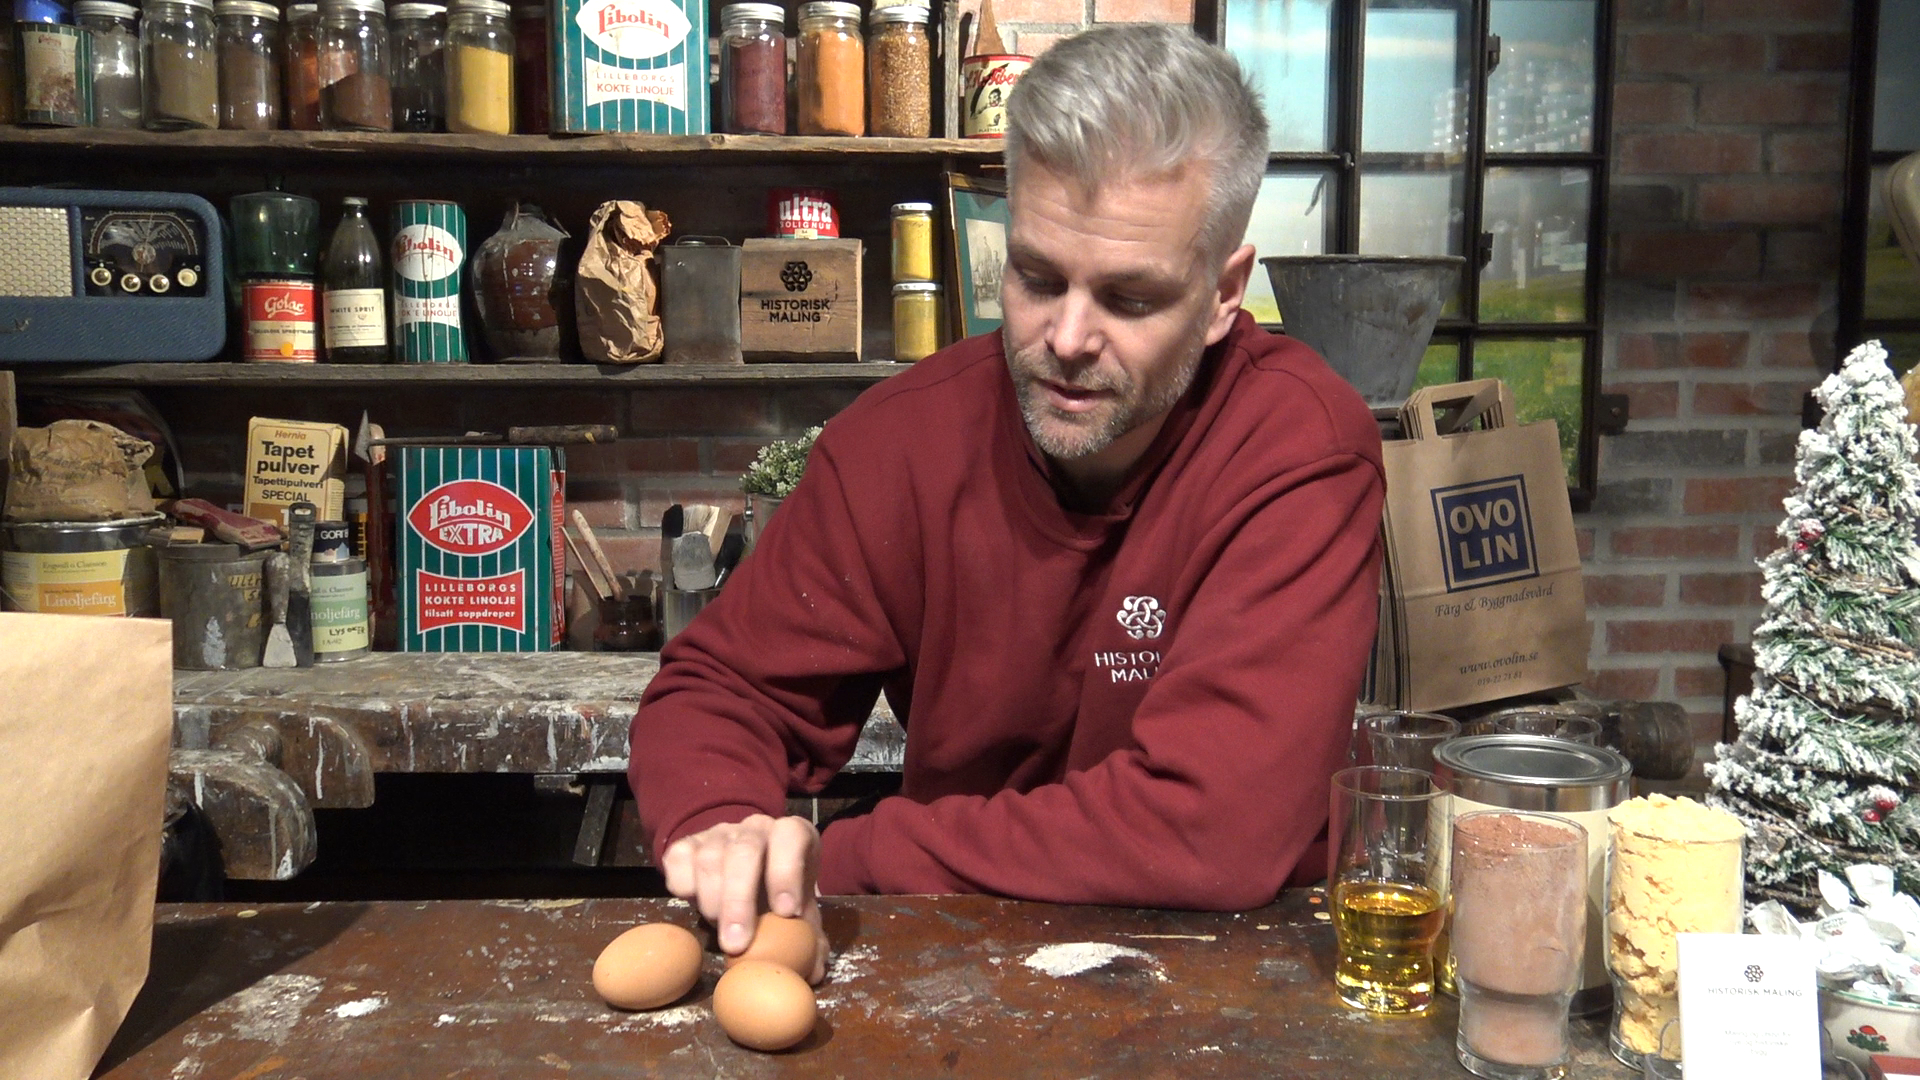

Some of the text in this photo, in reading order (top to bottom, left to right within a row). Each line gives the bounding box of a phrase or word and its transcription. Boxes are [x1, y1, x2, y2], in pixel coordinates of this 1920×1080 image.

[598, 4, 669, 39] Libolin
[596, 71, 675, 83] LILLEBORGS
[597, 83, 675, 96] KOKTE LINOLJE
[779, 194, 832, 223] ultra
[780, 220, 832, 230] SOLIGNUM
[264, 292, 306, 319] Golac
[761, 299, 830, 311] HISTORISK
[769, 311, 822, 323] MALING
[275, 429, 307, 440] Hernia
[262, 441, 315, 463] Tapet
[256, 457, 320, 475] pulver
[253, 475, 324, 489] Tapettipulveri
[262, 489, 311, 502] SPECIAL
[429, 495, 512, 532] Libolin
[1450, 498, 1516, 535] OVO
[439, 523, 504, 546] EXTRA
[1460, 532, 1519, 569] LIN
[425, 583, 517, 592] LILLEBORGS
[44, 592, 117, 611] Linoljefärg
[425, 596, 517, 605] KOKTE LINOLJE
[1435, 582, 1555, 617] Färg & Byggnadsvård
[311, 606, 361, 623] noljefärg
[425, 609, 516, 619] tilsatt soppdreper
[329, 627, 346, 636] LYS
[1094, 650, 1161, 667] HISTO
[1459, 651, 1539, 675] www.ovolin.se
[1111, 666, 1159, 683] MAL
[1707, 987, 1803, 998] HISTORISK MALING
